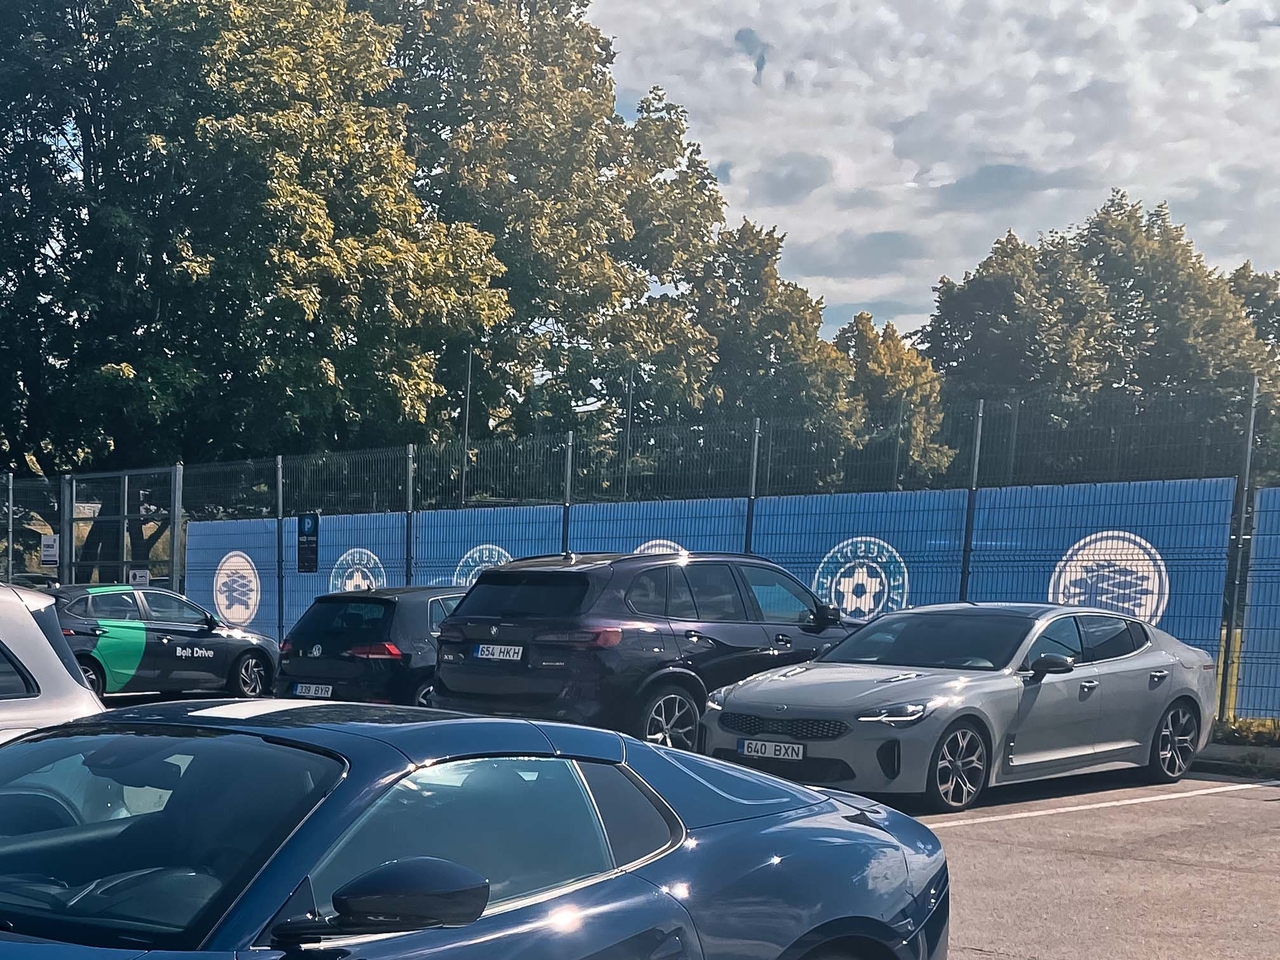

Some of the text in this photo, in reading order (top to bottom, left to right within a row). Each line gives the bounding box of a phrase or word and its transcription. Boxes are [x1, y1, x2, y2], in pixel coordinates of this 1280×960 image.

[305, 518, 312, 531] P
[176, 646, 214, 659] Bolt Drive
[480, 645, 521, 659] 654 HKH
[299, 685, 331, 696] 339 BYR
[746, 742, 800, 758] 640 BXN
